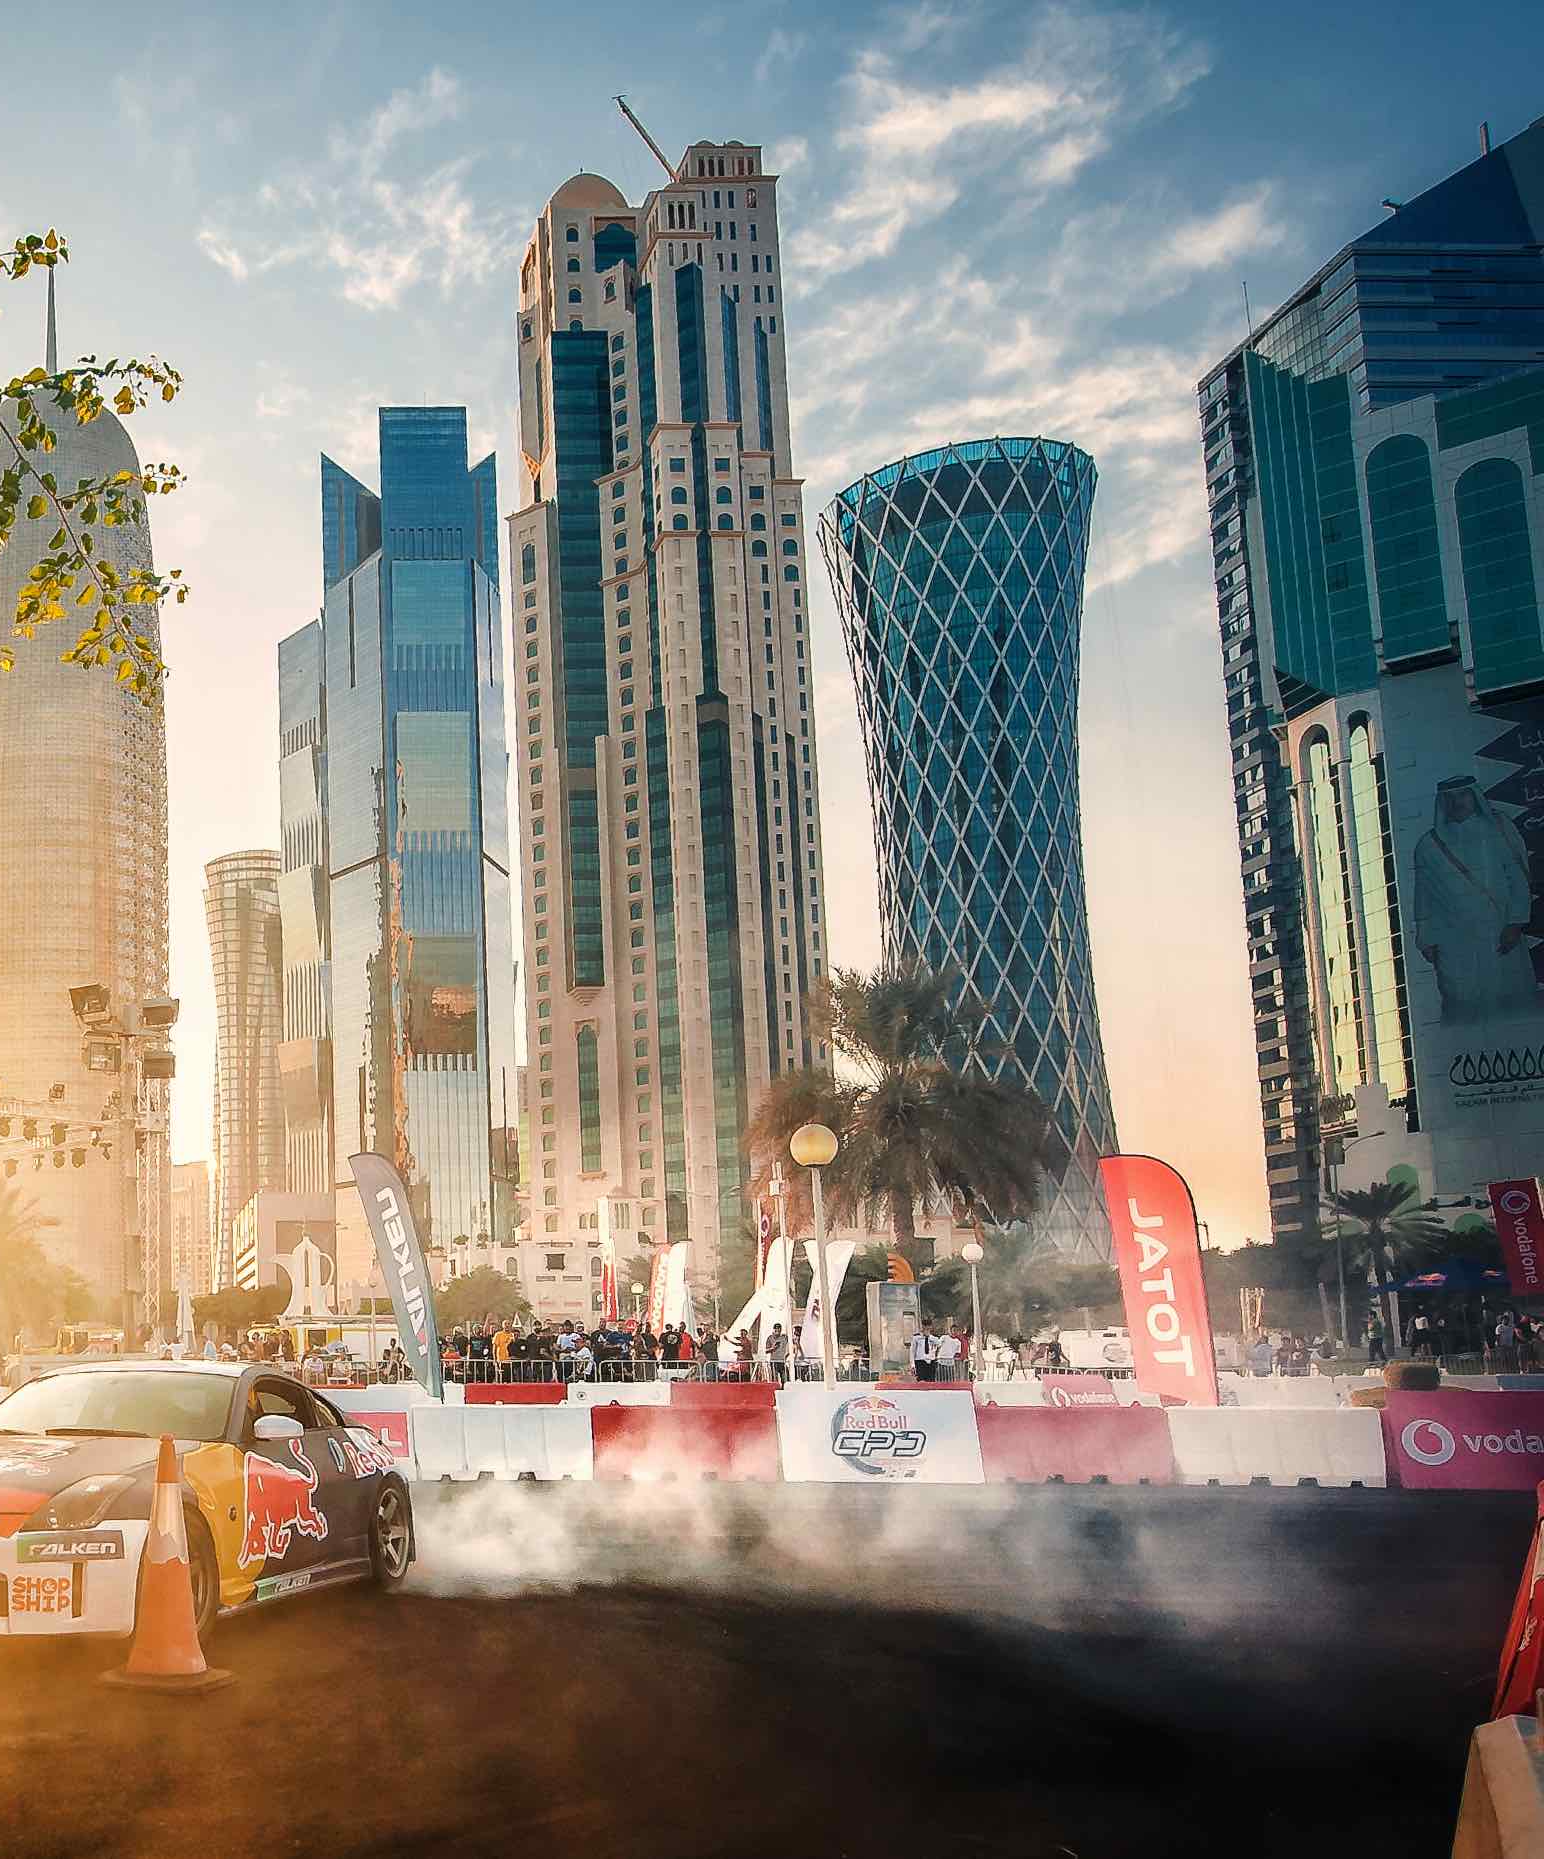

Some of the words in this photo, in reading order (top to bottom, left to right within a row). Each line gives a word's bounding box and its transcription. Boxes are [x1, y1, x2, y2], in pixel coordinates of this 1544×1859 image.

[1513, 1217, 1539, 1285] vodafone
[845, 1415, 876, 1429] Red
[877, 1415, 907, 1429] Bull
[29, 1542, 117, 1556] FALKEN
[12, 1576, 71, 1595] SHOP
[12, 1595, 71, 1612] SHIP
